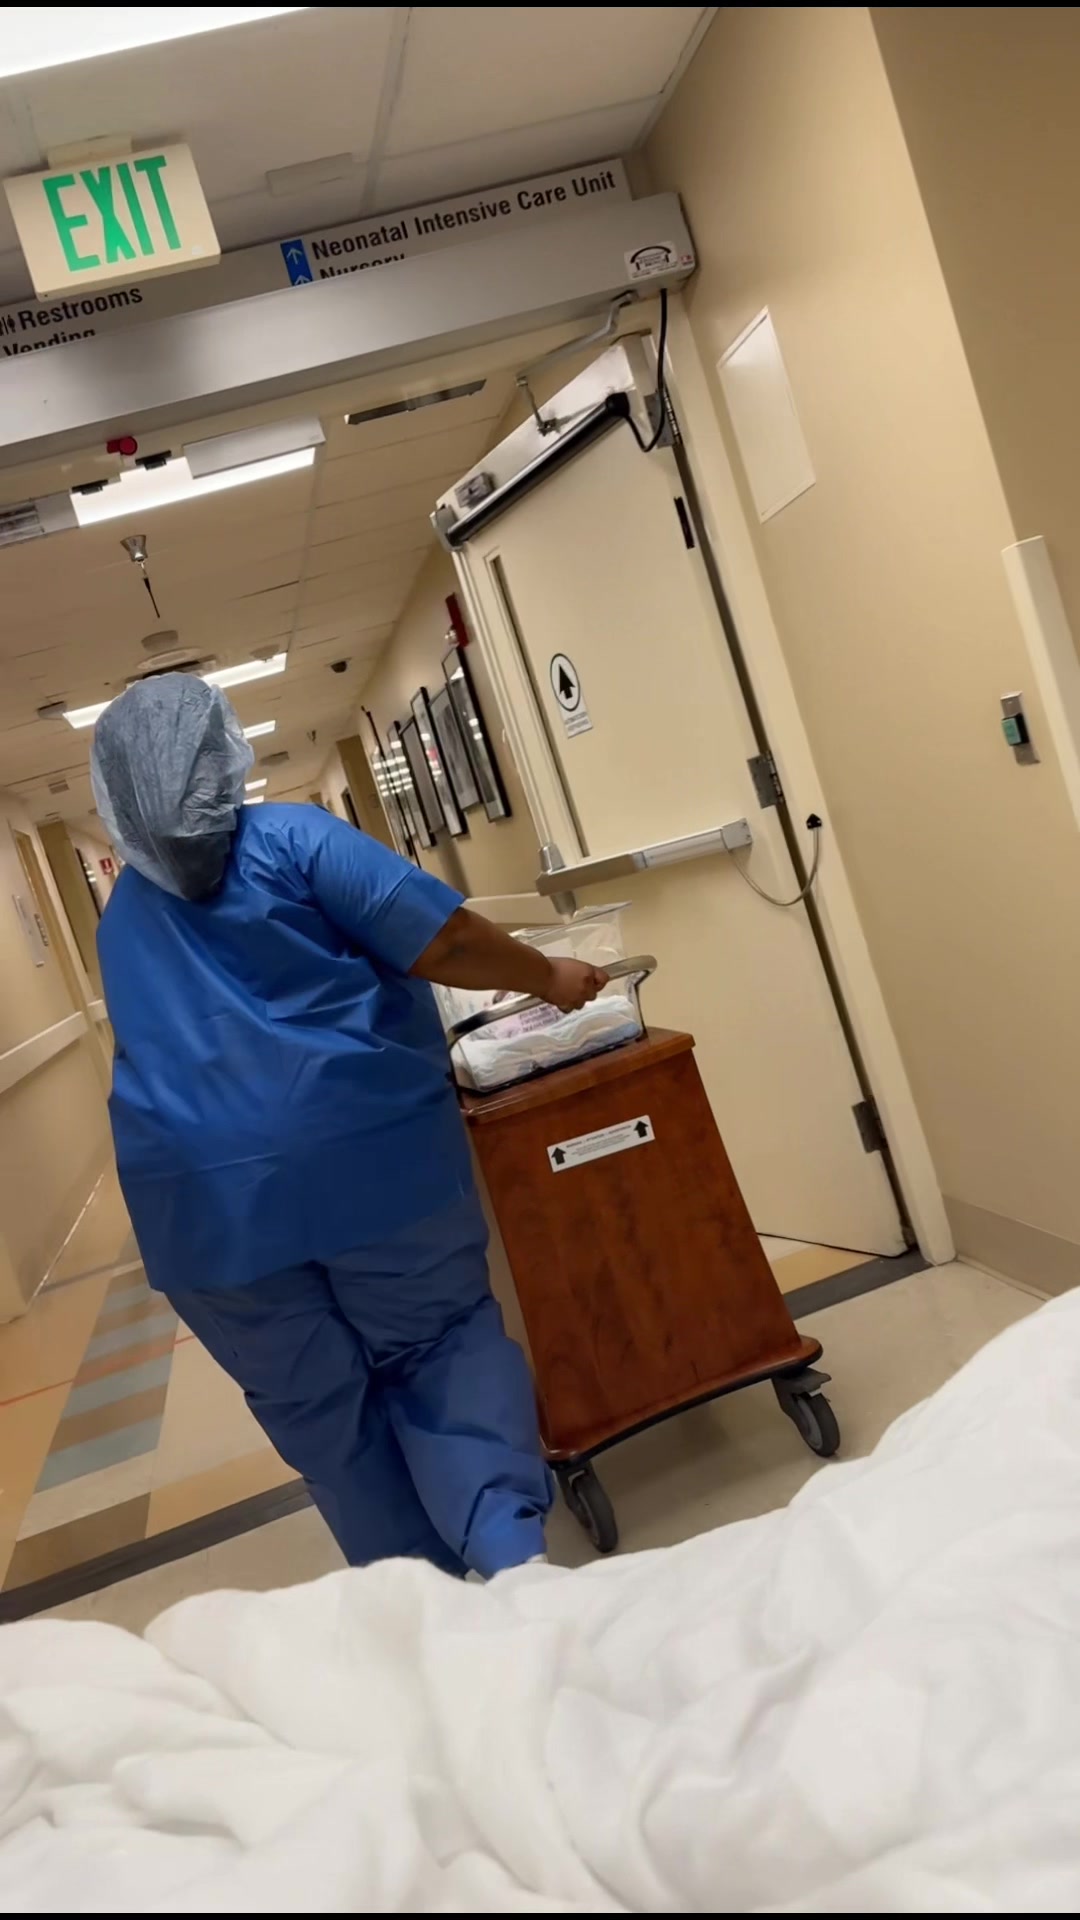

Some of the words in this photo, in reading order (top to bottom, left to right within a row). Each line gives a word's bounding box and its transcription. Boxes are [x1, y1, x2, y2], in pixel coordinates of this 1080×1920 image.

[42, 155, 181, 272] EXIT
[311, 220, 409, 260] Neonatal
[414, 200, 512, 236] Intensive
[517, 186, 567, 211] Care
[571, 171, 616, 197] Unit
[18, 288, 143, 331] Restrooms
